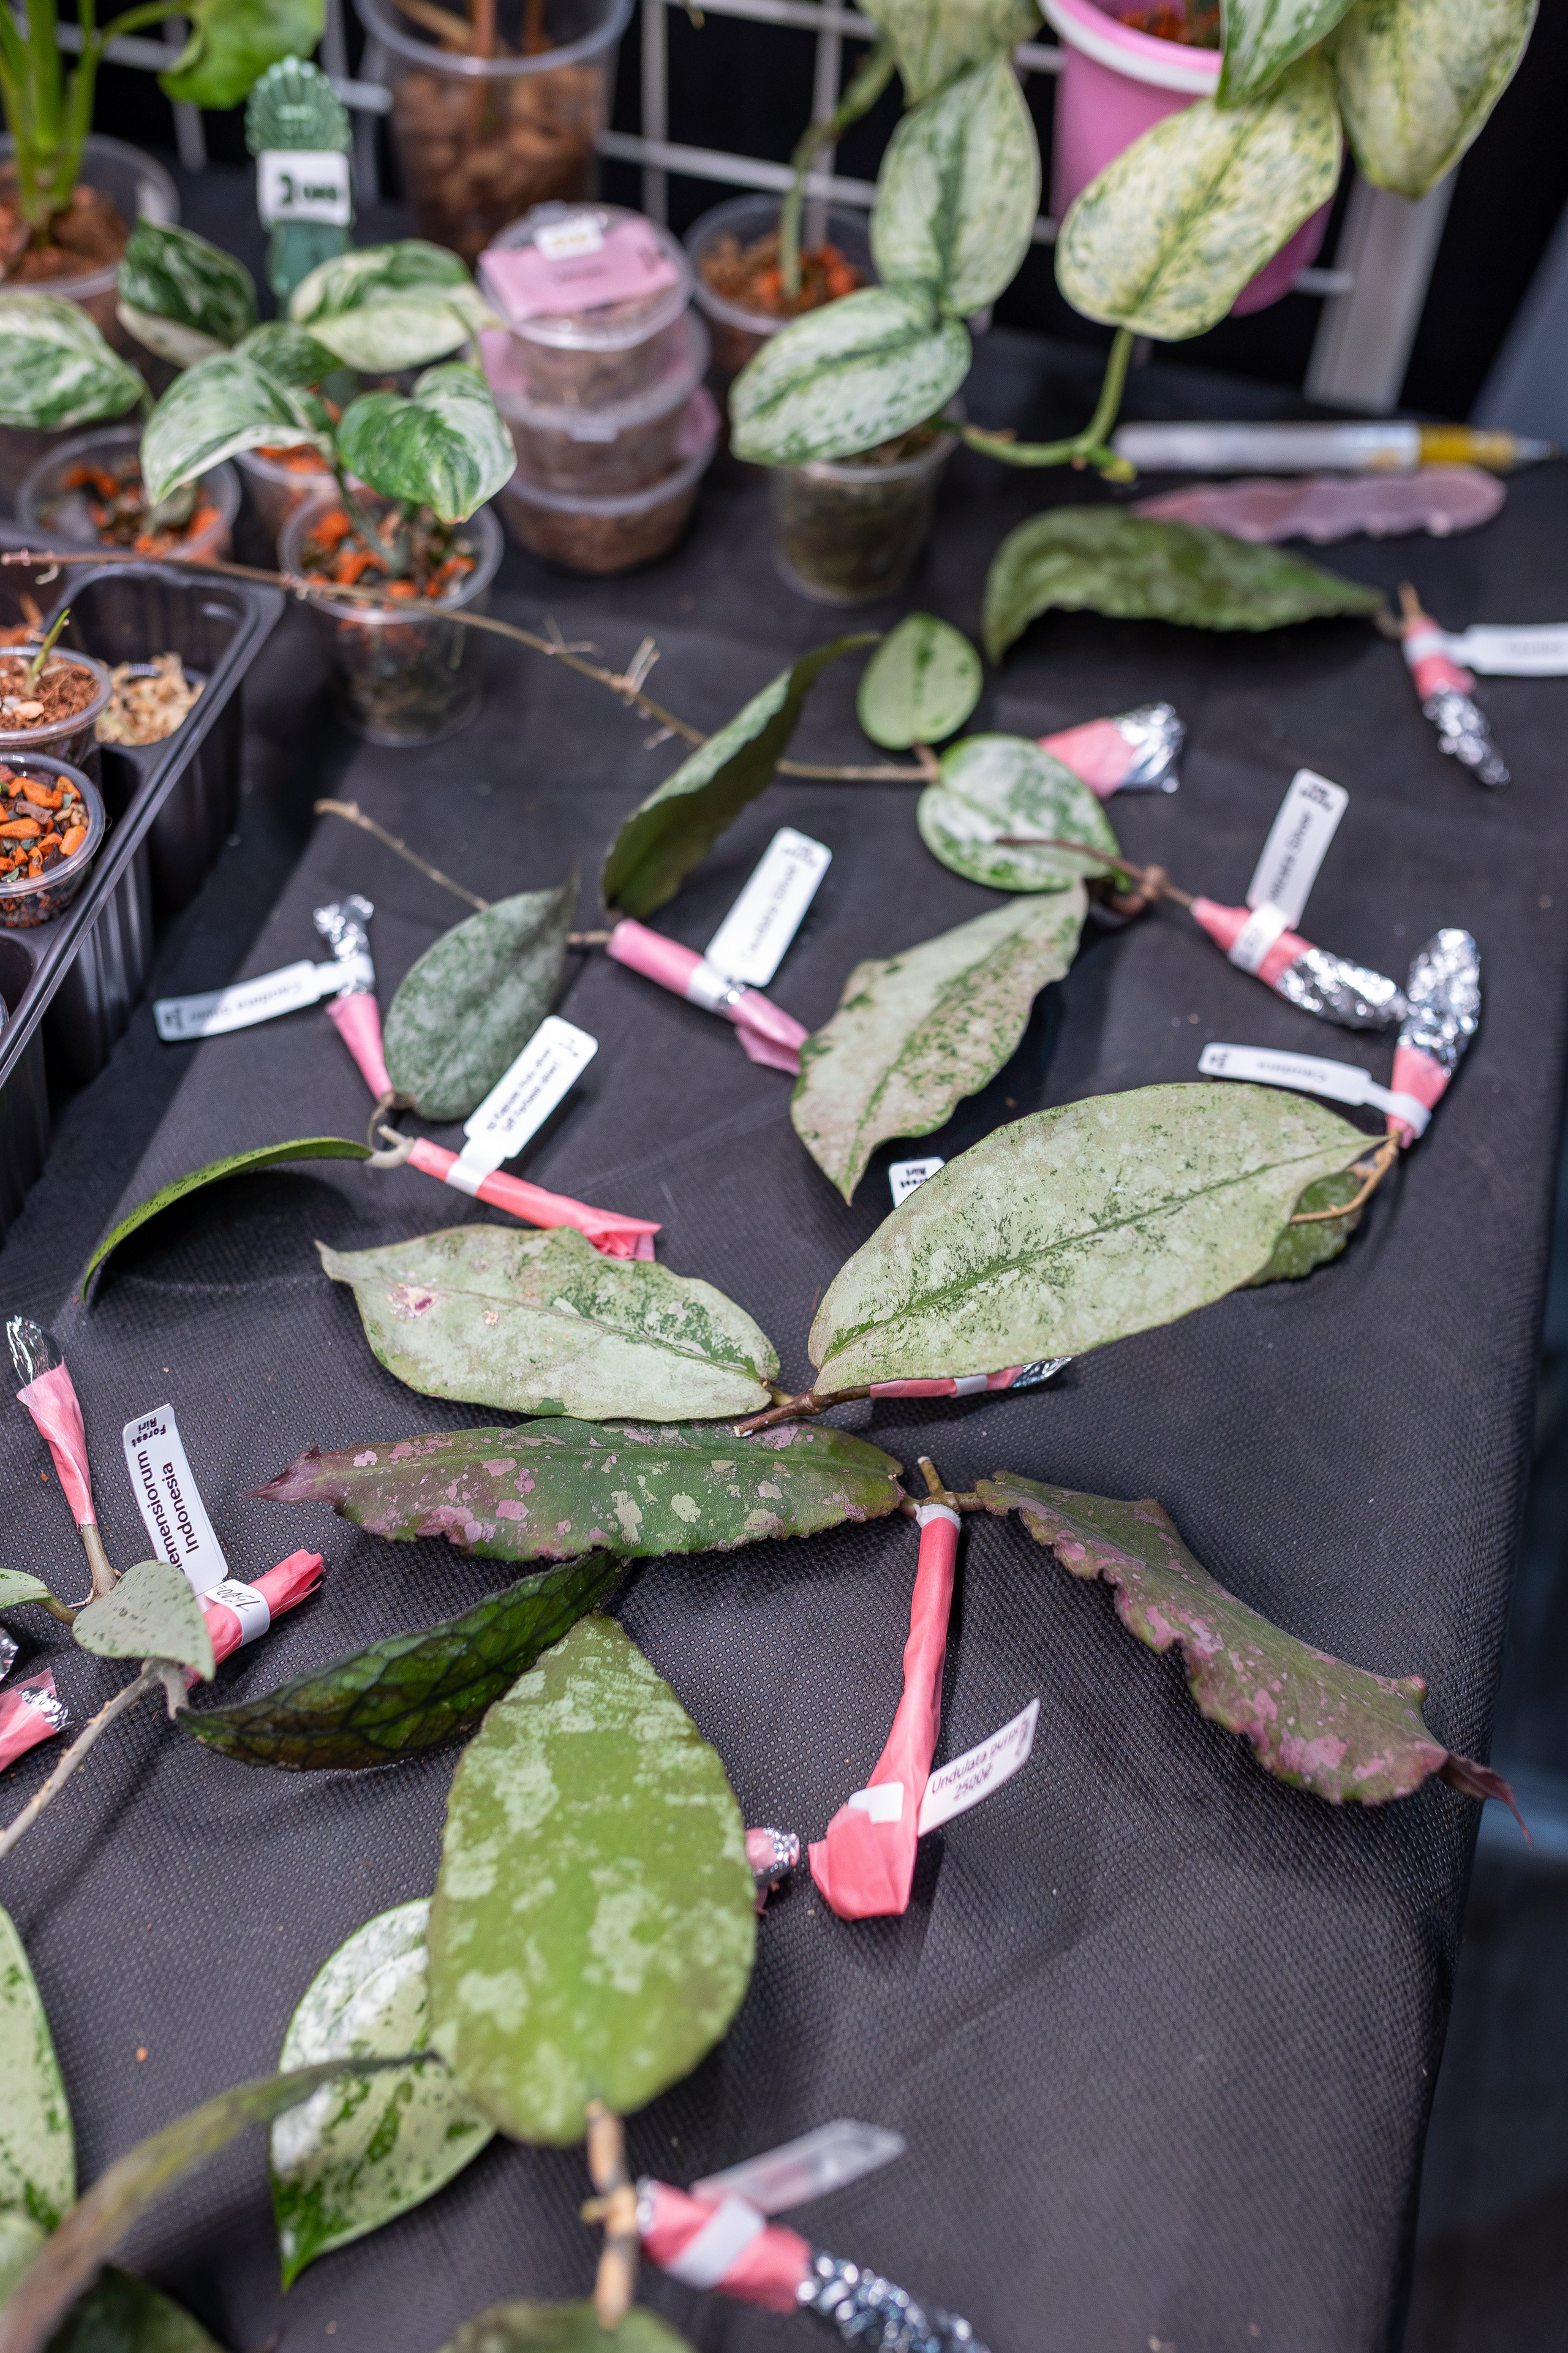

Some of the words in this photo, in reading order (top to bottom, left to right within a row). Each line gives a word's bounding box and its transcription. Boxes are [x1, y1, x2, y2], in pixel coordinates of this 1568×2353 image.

[132, 1424, 167, 1448] Forest
[138, 1417, 157, 1433] Riri
[162, 1462, 199, 1554] Indonesia
[932, 1751, 987, 1794] Undulata
